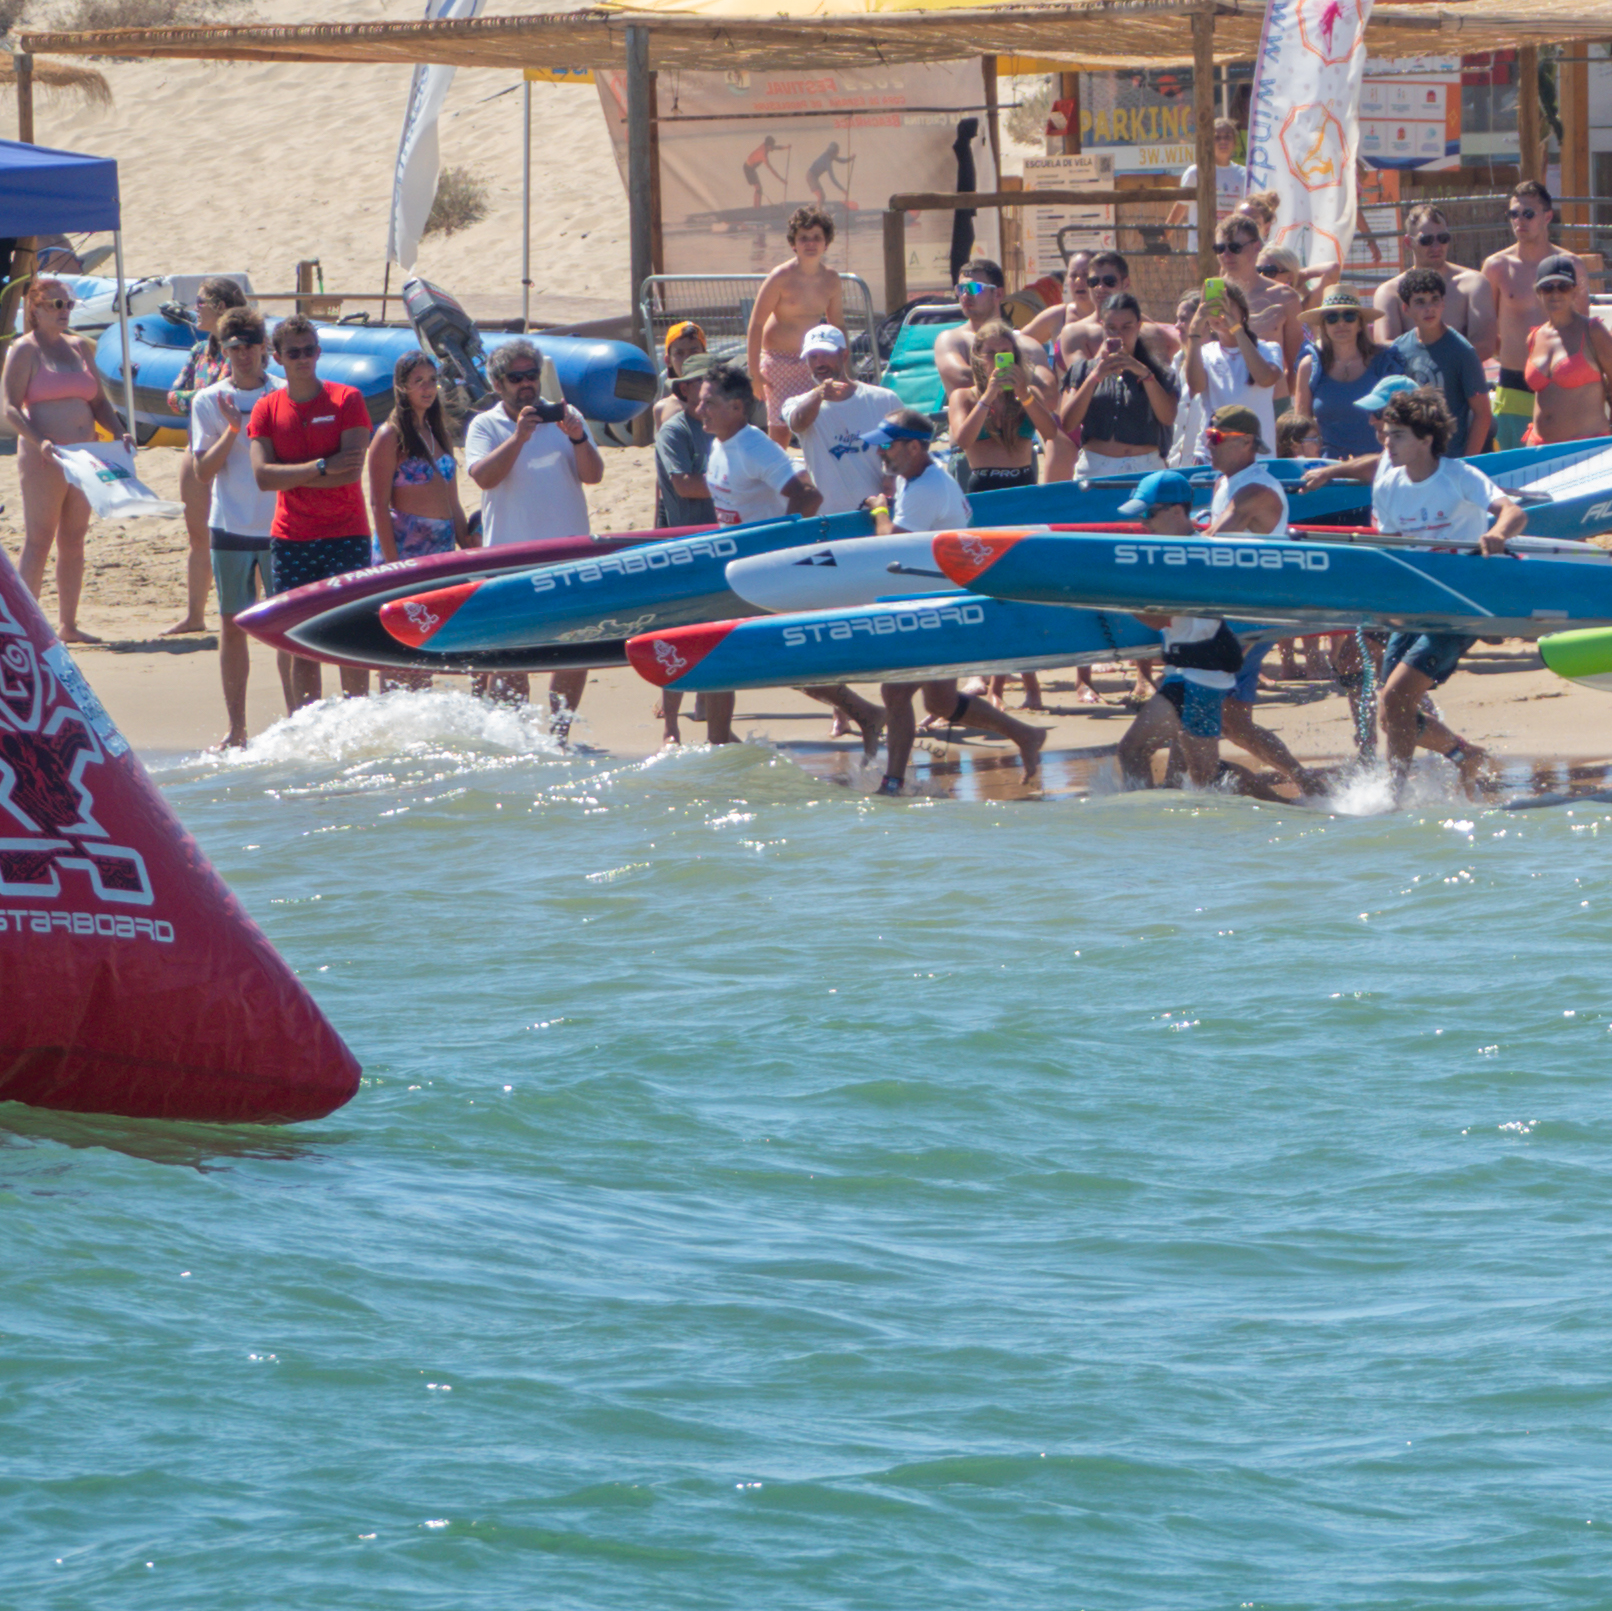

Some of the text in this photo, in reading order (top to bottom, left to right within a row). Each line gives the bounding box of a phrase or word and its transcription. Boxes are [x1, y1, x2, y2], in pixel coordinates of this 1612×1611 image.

[1025, 157, 1092, 169] ESCUELA DE VELA
[344, 558, 418, 582] FANATIC
